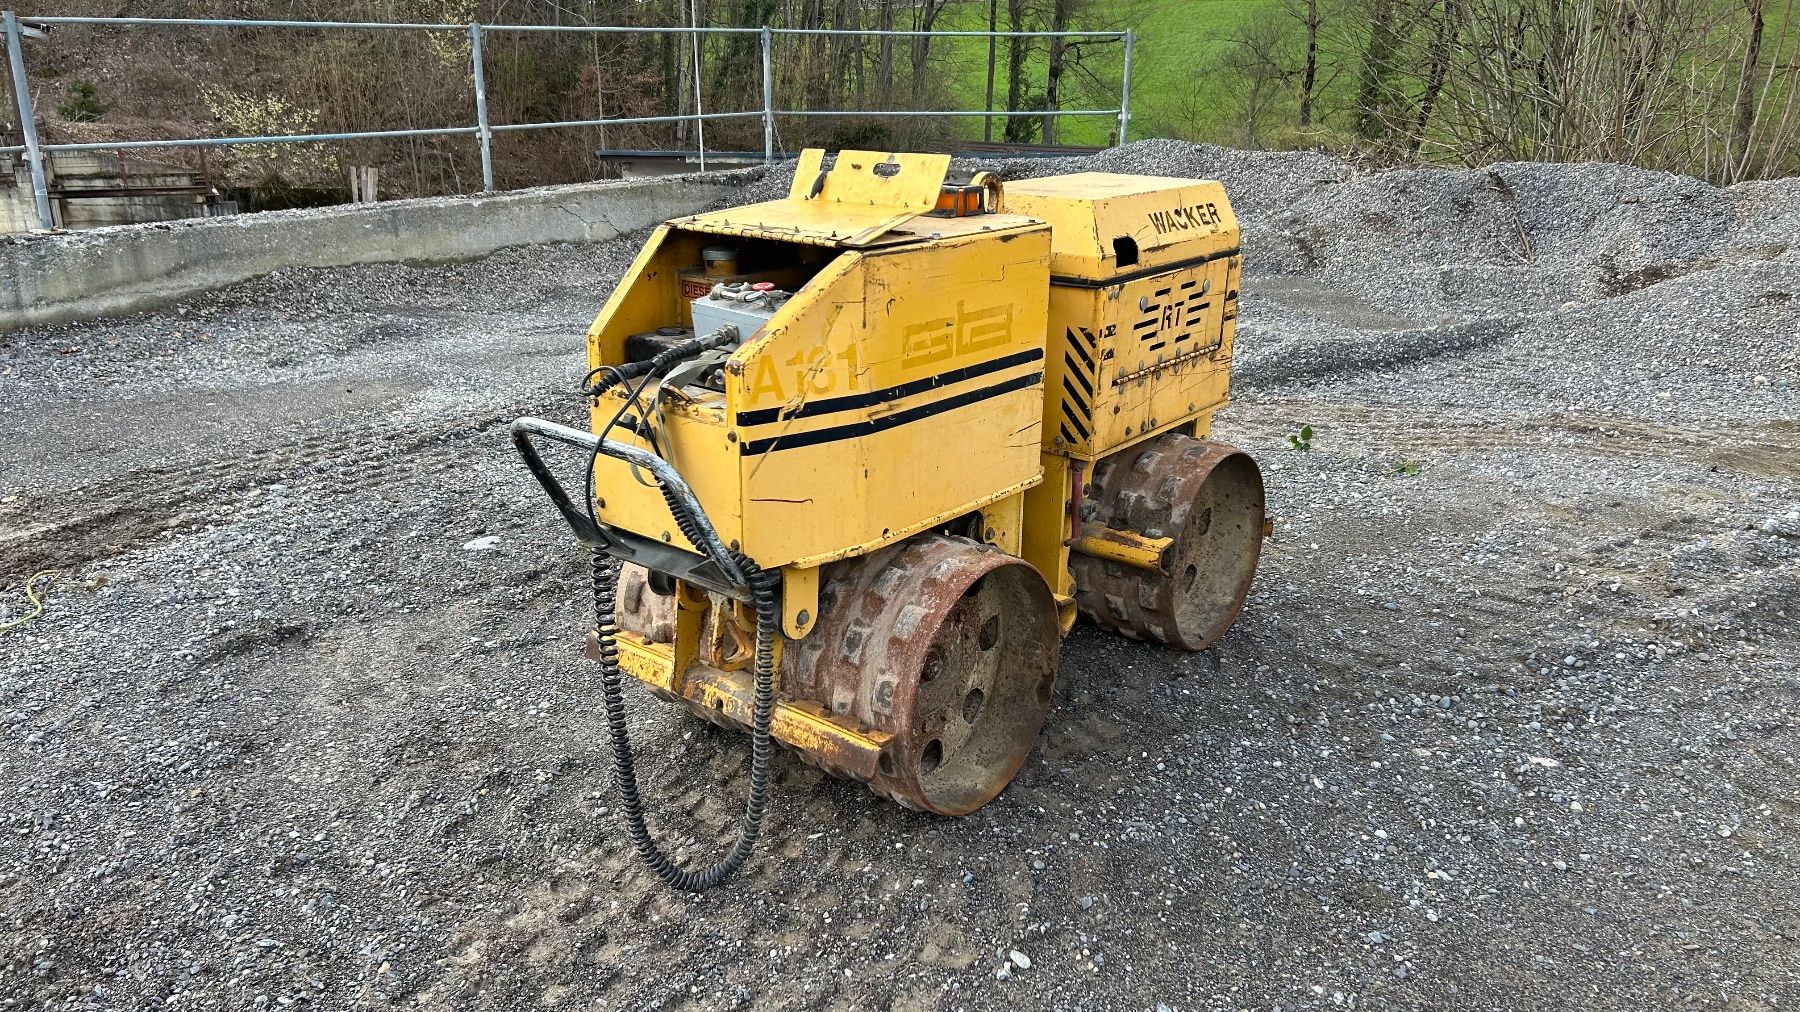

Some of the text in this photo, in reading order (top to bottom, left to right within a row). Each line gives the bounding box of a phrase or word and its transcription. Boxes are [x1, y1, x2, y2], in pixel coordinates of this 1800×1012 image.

[1148, 203, 1221, 234] WACKER
[684, 284, 711, 297] DIESE
[1160, 301, 1185, 330] RT
